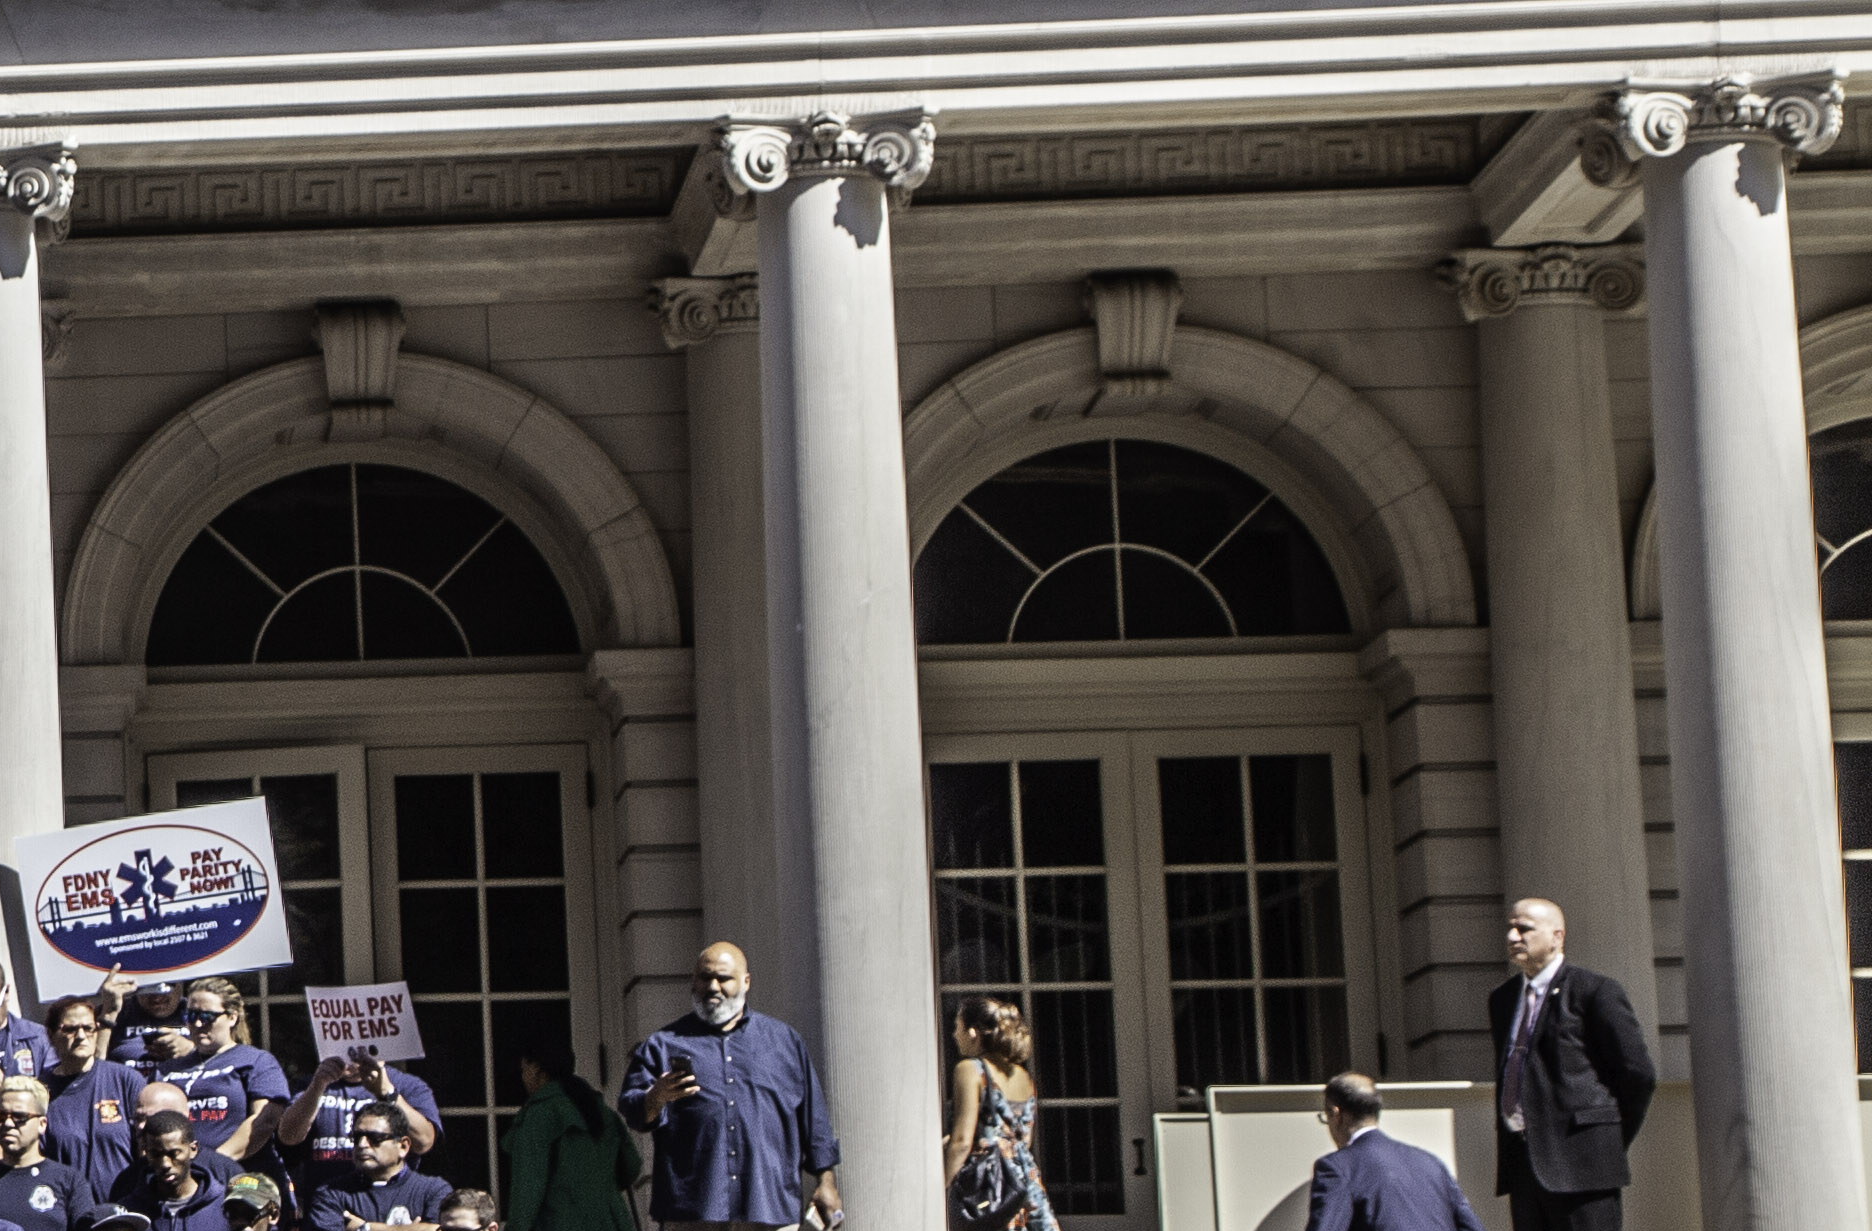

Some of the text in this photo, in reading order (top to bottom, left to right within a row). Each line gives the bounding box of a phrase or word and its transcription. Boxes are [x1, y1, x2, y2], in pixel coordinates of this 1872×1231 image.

[191, 847, 224, 865] PAY
[63, 869, 111, 893] FDNY
[179, 859, 243, 881] PARITY
[190, 877, 235, 894] NOW!
[66, 889, 115, 912] EMS
[312, 993, 404, 1019] EQUAL PAY
[321, 1017, 400, 1041] FOR EMS
